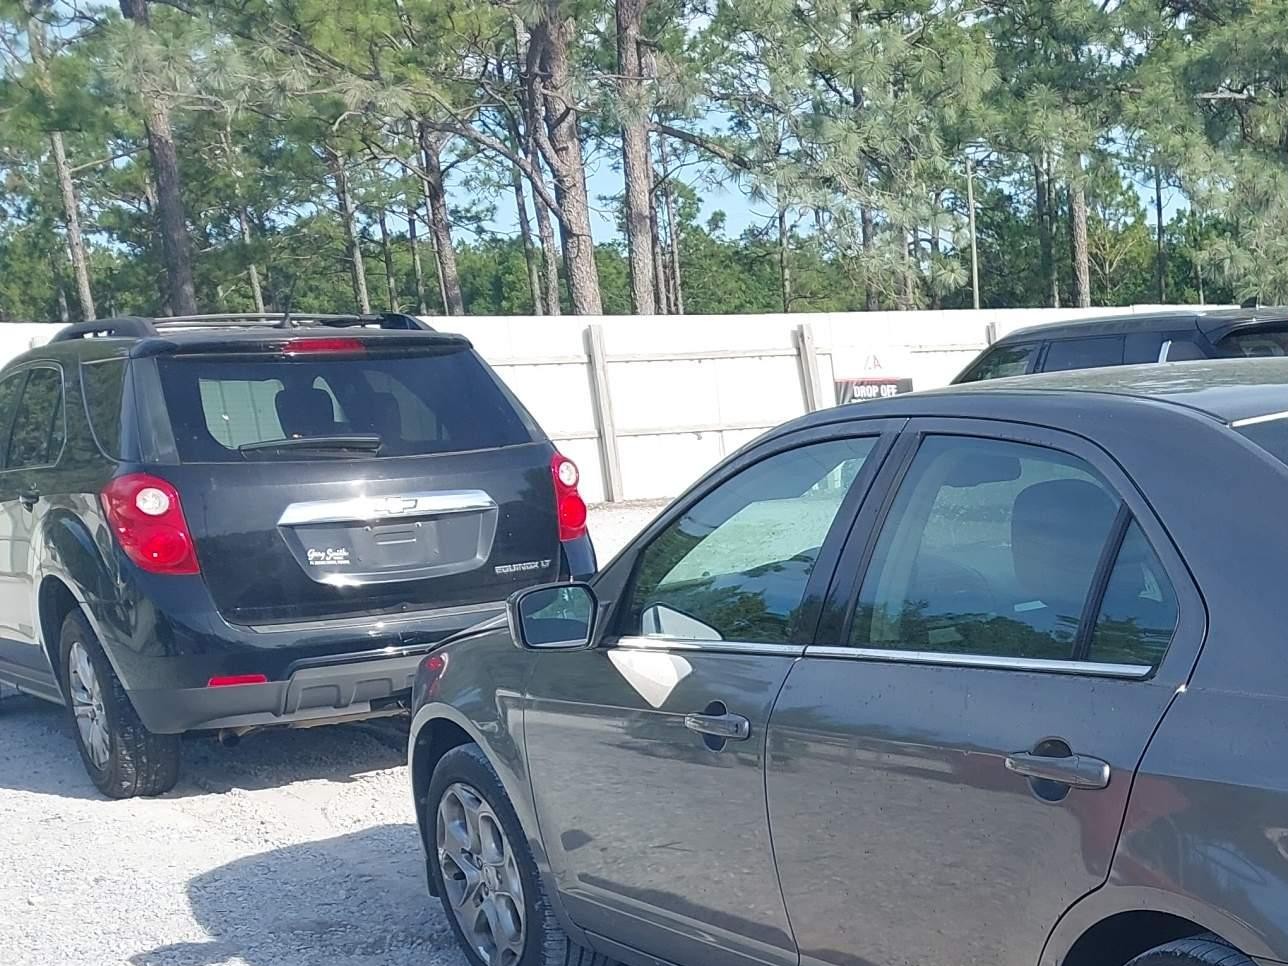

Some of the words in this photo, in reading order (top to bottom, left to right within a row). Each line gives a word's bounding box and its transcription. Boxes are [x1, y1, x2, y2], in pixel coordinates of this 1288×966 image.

[853, 384, 879, 398] DROP
[880, 384, 898, 398] OFF
[494, 561, 539, 574] EQUINOX
